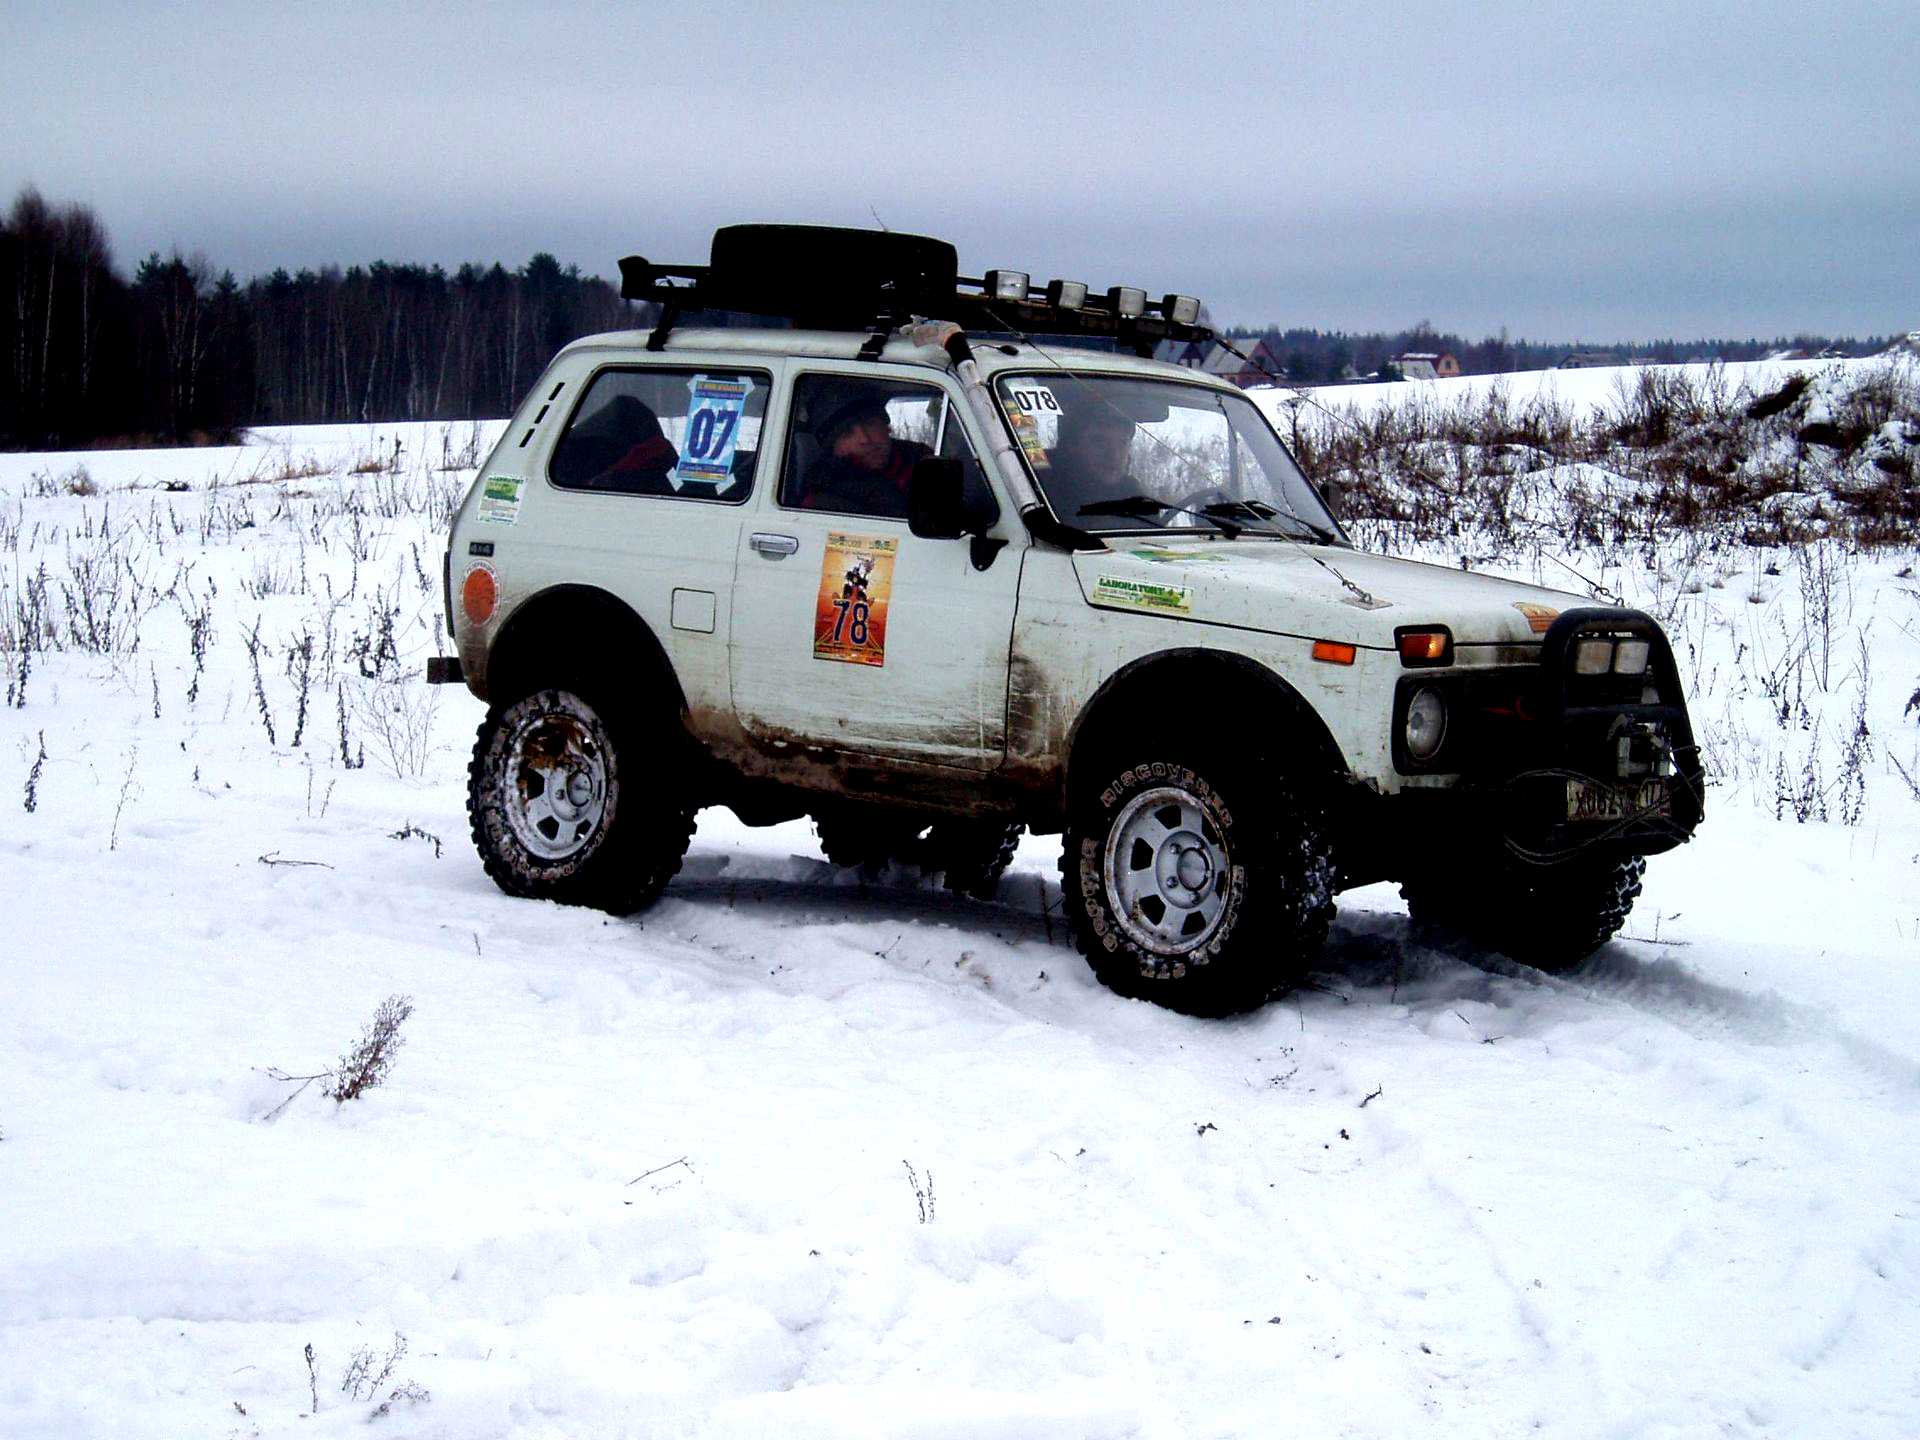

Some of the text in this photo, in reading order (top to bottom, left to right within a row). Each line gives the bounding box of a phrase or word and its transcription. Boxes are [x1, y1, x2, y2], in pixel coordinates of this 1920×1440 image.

[1014, 390, 1058, 411] 078
[687, 408, 739, 460] 07
[832, 598, 869, 645] 78
